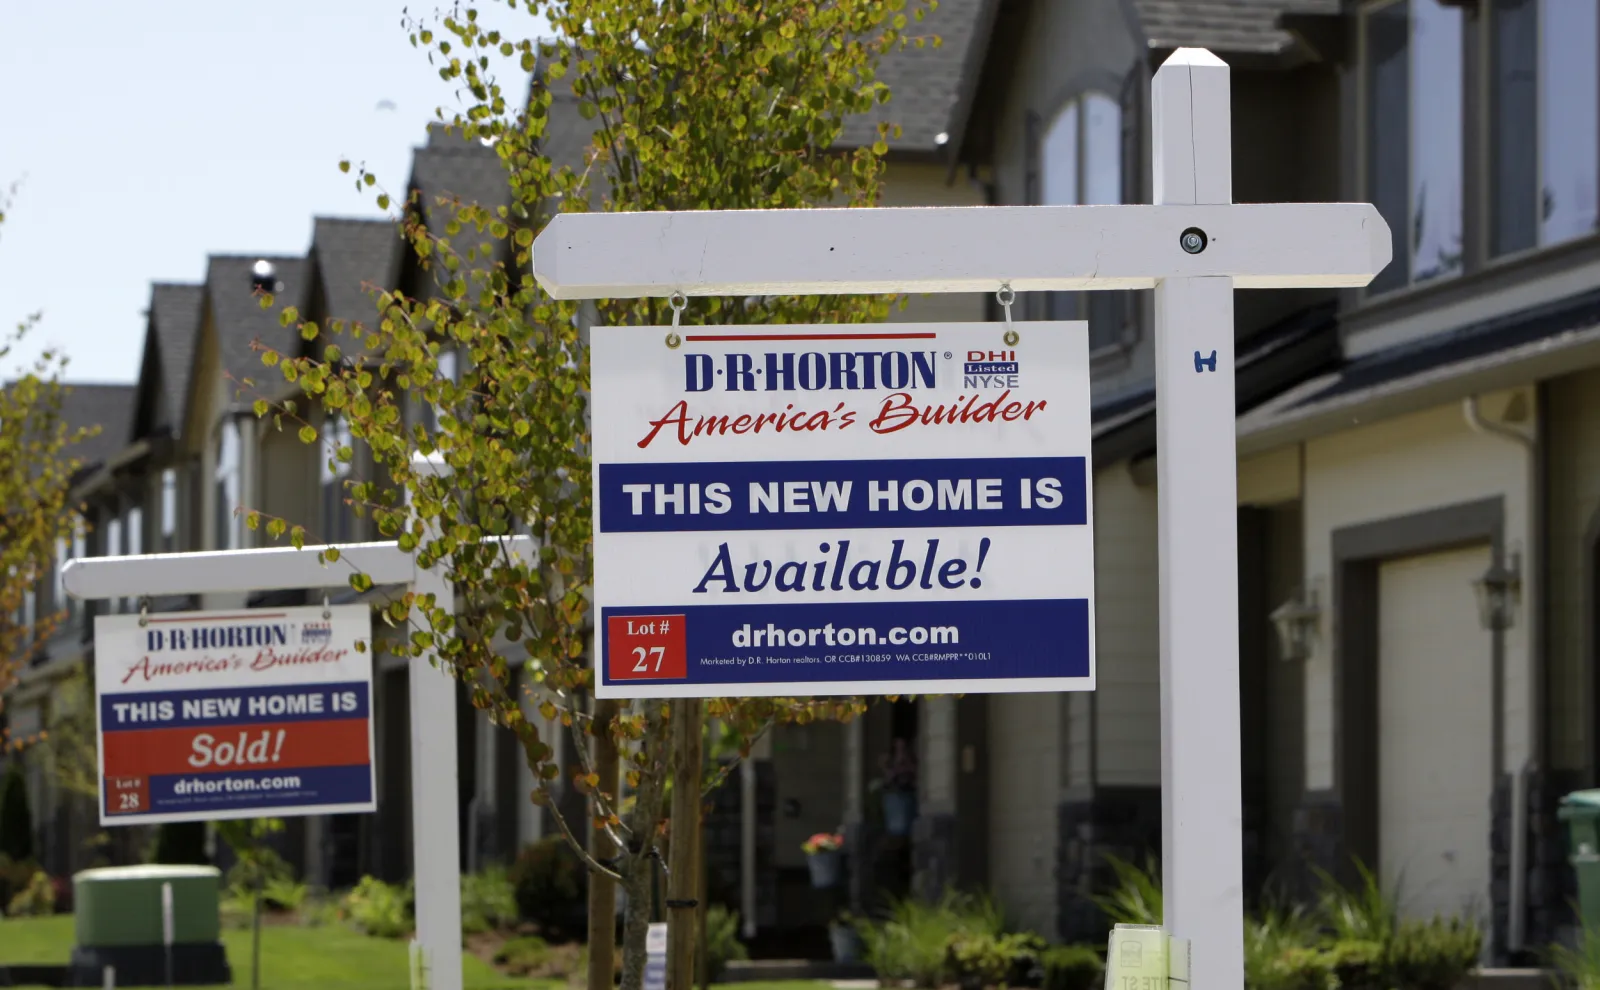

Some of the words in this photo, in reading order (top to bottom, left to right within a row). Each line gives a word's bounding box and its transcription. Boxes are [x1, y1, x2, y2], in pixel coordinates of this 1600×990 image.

[967, 350, 1016, 362] DHI
[1194, 350, 1217, 373] H
[967, 364, 1016, 373] Listed
[964, 374, 1019, 389] NYSE
[637, 400, 856, 448] America's
[869, 390, 1047, 434] Builder
[622, 482, 732, 515] THIS
[749, 480, 853, 514] NEW
[868, 478, 1003, 512] HOME
[1020, 477, 1064, 509] IS
[692, 537, 991, 594] Available!
[627, 620, 655, 636] Lot
[659, 619, 670, 635] #
[732, 622, 960, 648] drhorton.com
[249, 644, 348, 672] Builder
[631, 646, 666, 672] 27
[700, 656, 735, 666] Marketed
[736, 656, 747, 667] by
[766, 656, 791, 665] Horton
[824, 655, 837, 663] OR
[838, 654, 892, 663] CCB#130859
[895, 654, 911, 662] WA
[112, 700, 175, 723] THIS
[182, 697, 241, 720] NEW
[248, 693, 324, 717] HOME
[332, 691, 358, 712] IS
[187, 729, 287, 768] Sold!
[173, 774, 301, 795] drhorton.com
[119, 792, 140, 810] 28
